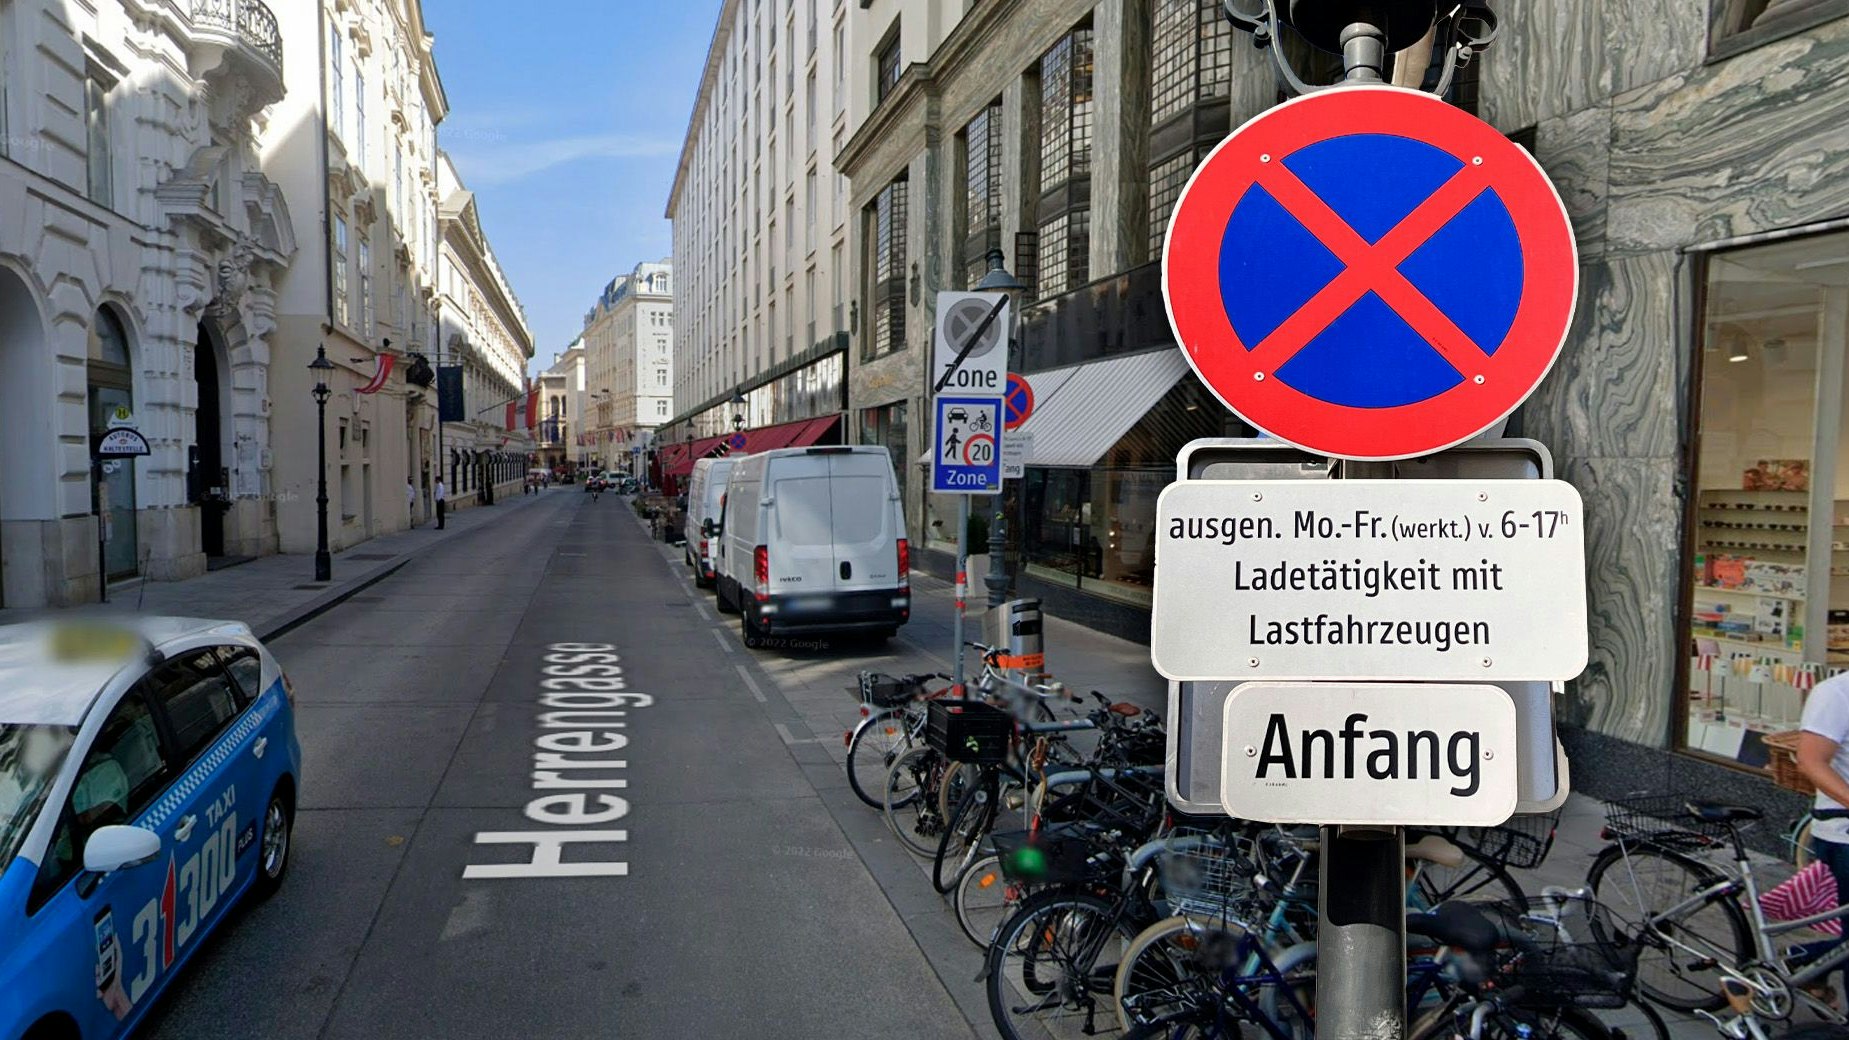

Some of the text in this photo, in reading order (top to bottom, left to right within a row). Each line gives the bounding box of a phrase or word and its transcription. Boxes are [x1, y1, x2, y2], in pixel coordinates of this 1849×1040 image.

[944, 363, 998, 388] Zone
[972, 444, 991, 461] 20
[946, 470, 987, 486] Zone
[1169, 517, 1282, 546] ausgen.
[1391, 514, 1471, 542] (werkt.)
[1478, 523, 1493, 539] v.
[1235, 558, 1503, 598] Ladetätigkeit mit
[1249, 613, 1490, 652] Lastfahrzeugen
[463, 642, 654, 879] Herrengasse
[1255, 713, 1480, 797] Anfang
[206, 784, 237, 828] TAXI
[237, 827, 254, 851] PLUS
[130, 810, 238, 1005] 31300
